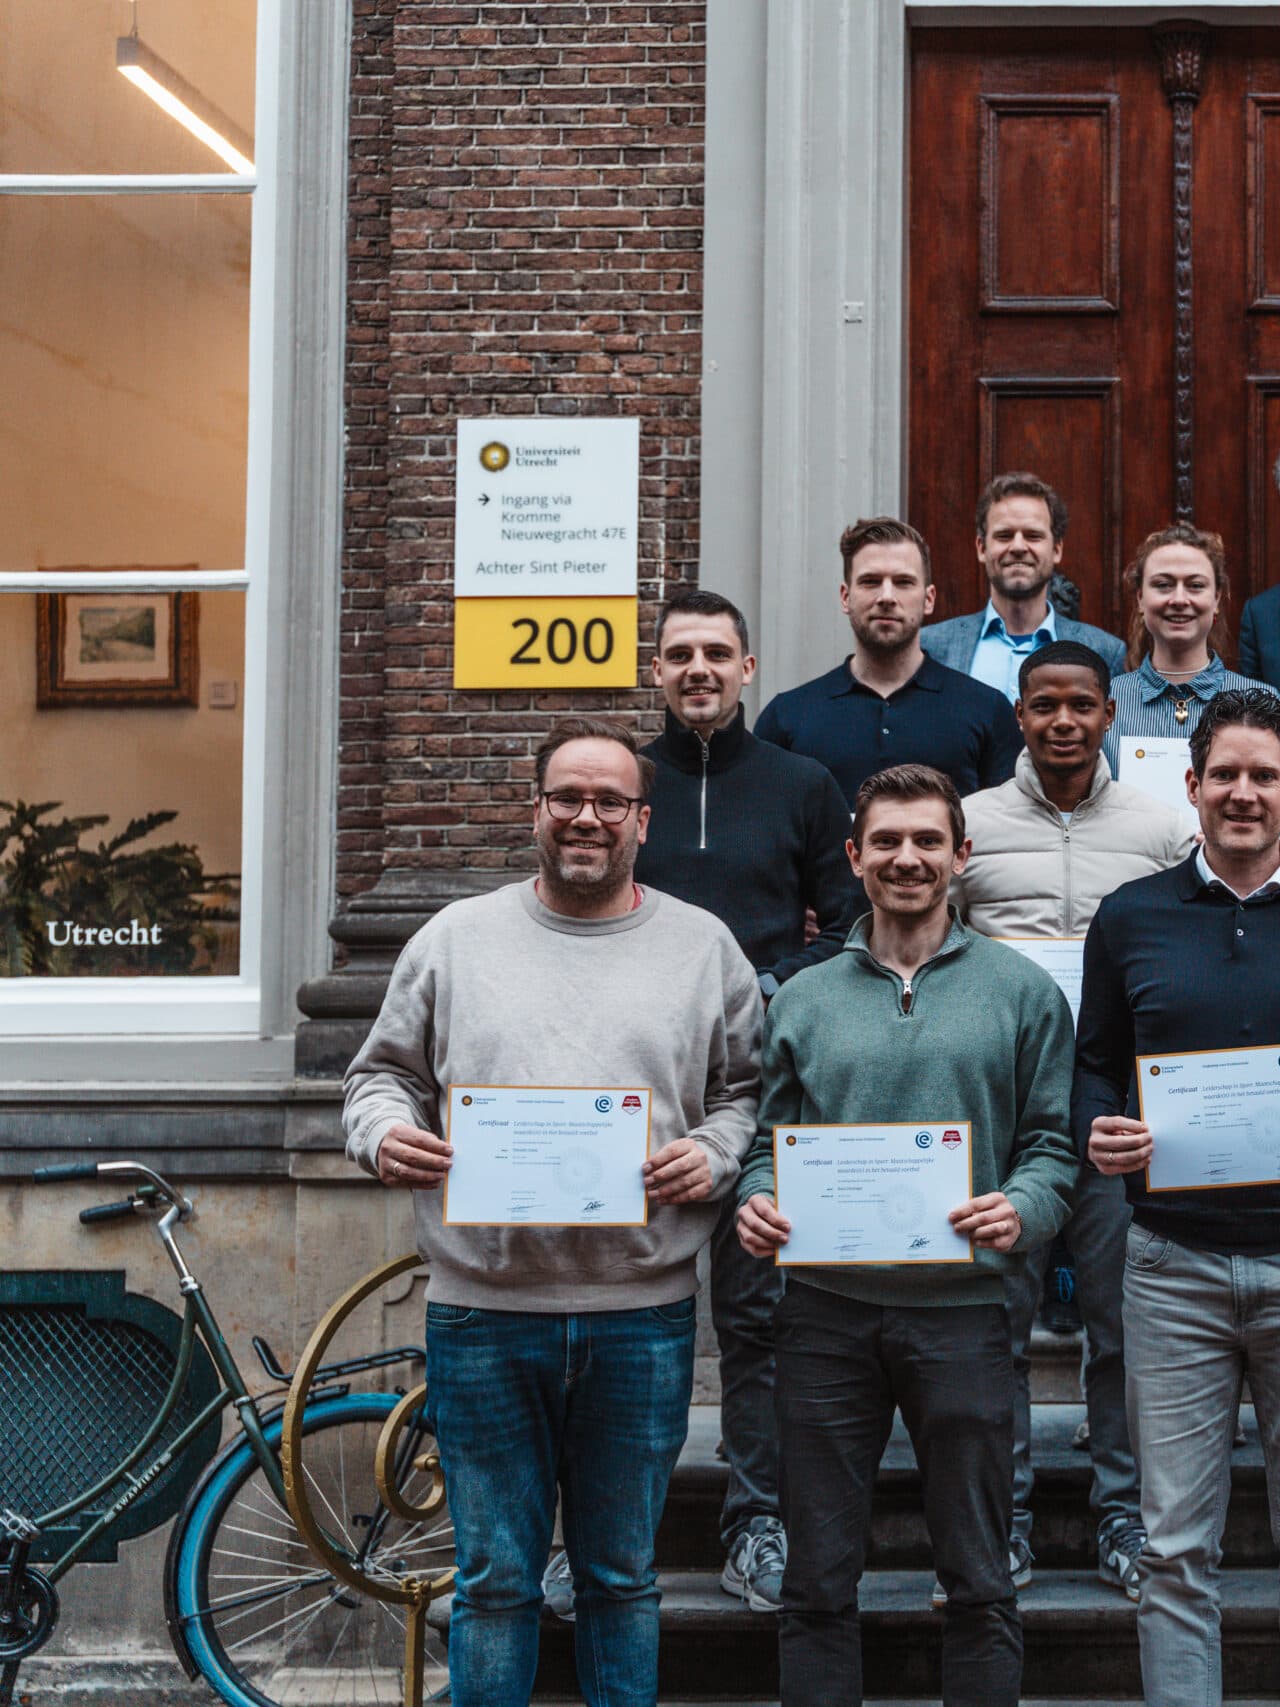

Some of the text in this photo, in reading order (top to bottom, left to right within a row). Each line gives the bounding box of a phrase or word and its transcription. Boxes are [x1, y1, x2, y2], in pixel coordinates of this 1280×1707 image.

[516, 446, 581, 457] Universiteit
[516, 457, 558, 467] Utrecht
[502, 494, 572, 508] Ingang via
[501, 512, 561, 523] Kromme
[501, 528, 627, 544] Nieuwegracht 47E
[476, 560, 607, 574] Achter Sint Pieter
[510, 617, 614, 665] 200
[45, 919, 162, 946] Utrecht
